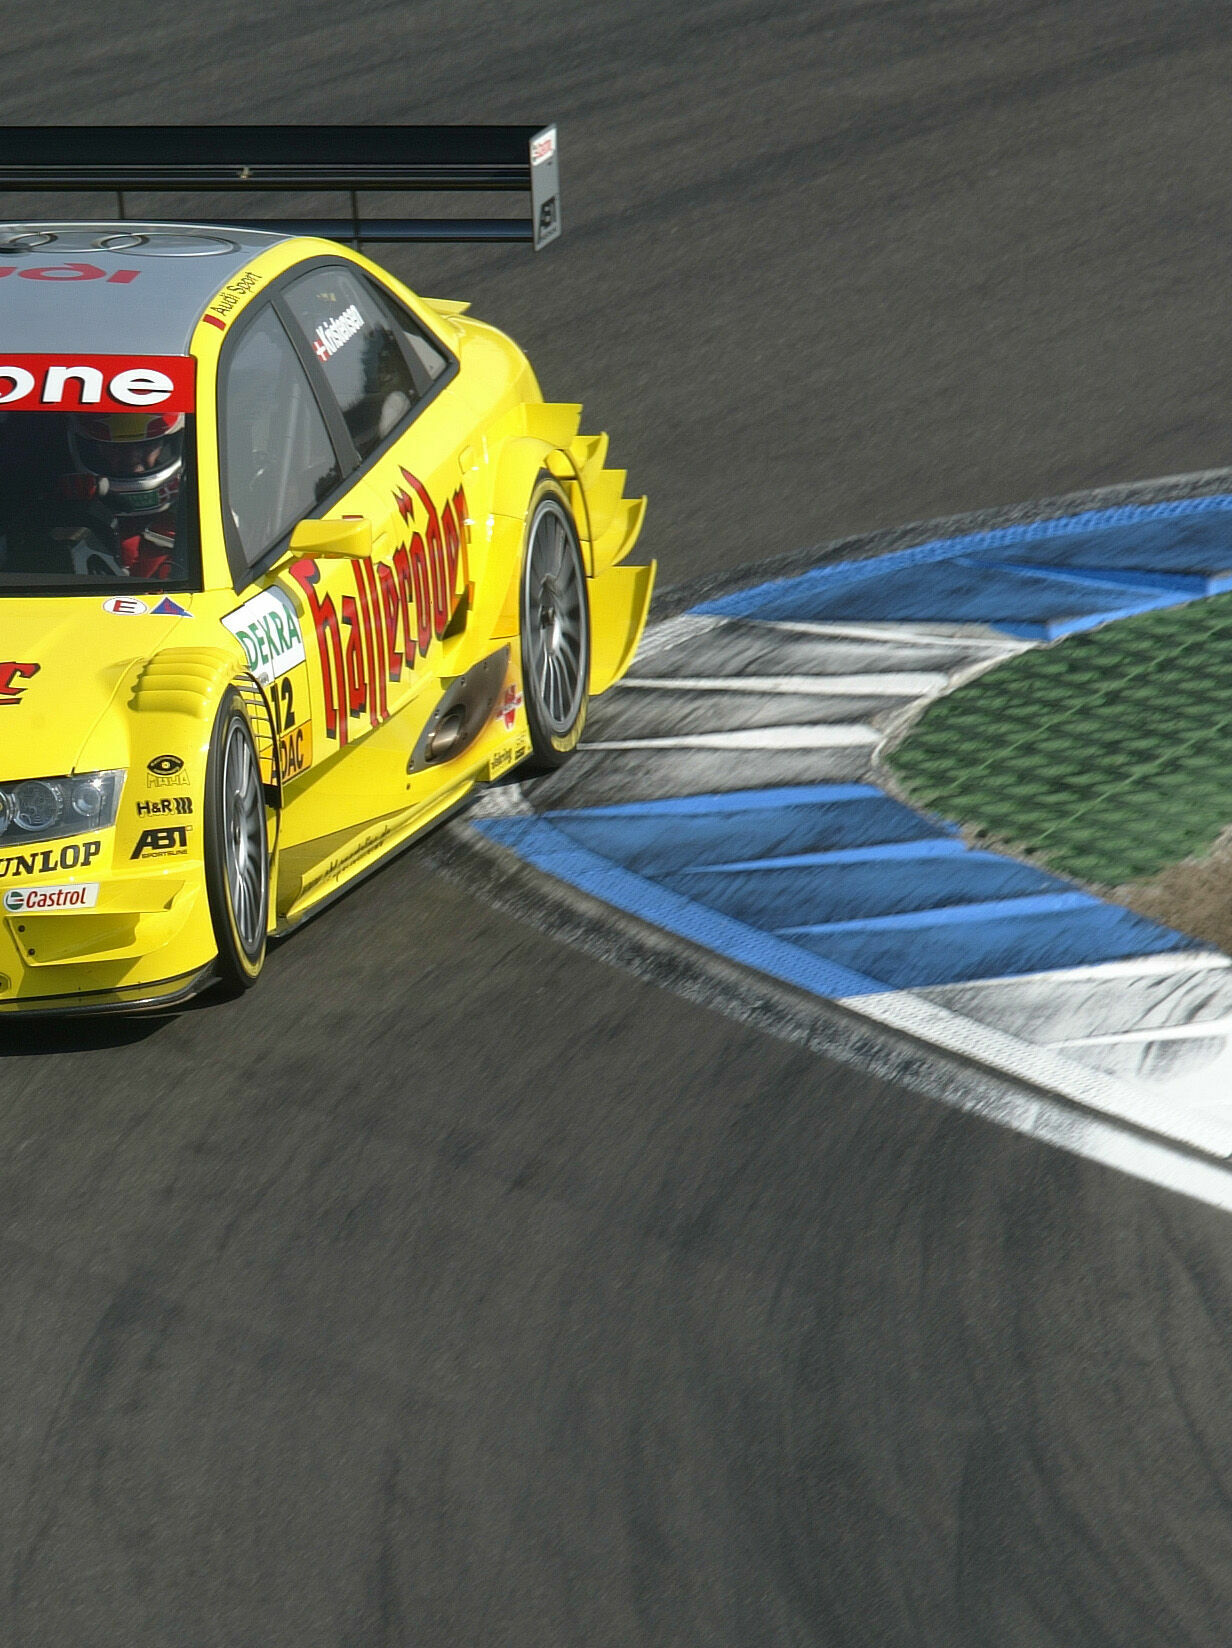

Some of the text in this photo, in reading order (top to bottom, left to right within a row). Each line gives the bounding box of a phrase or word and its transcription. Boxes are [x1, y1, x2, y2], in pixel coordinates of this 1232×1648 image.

[210, 271, 263, 316] Audi Sport
[235, 604, 301, 673] DEKRA
[270, 676, 295, 736] 12
[137, 798, 173, 817] H&R
[130, 826, 188, 860] ABT
[26, 887, 87, 909] Castrol
